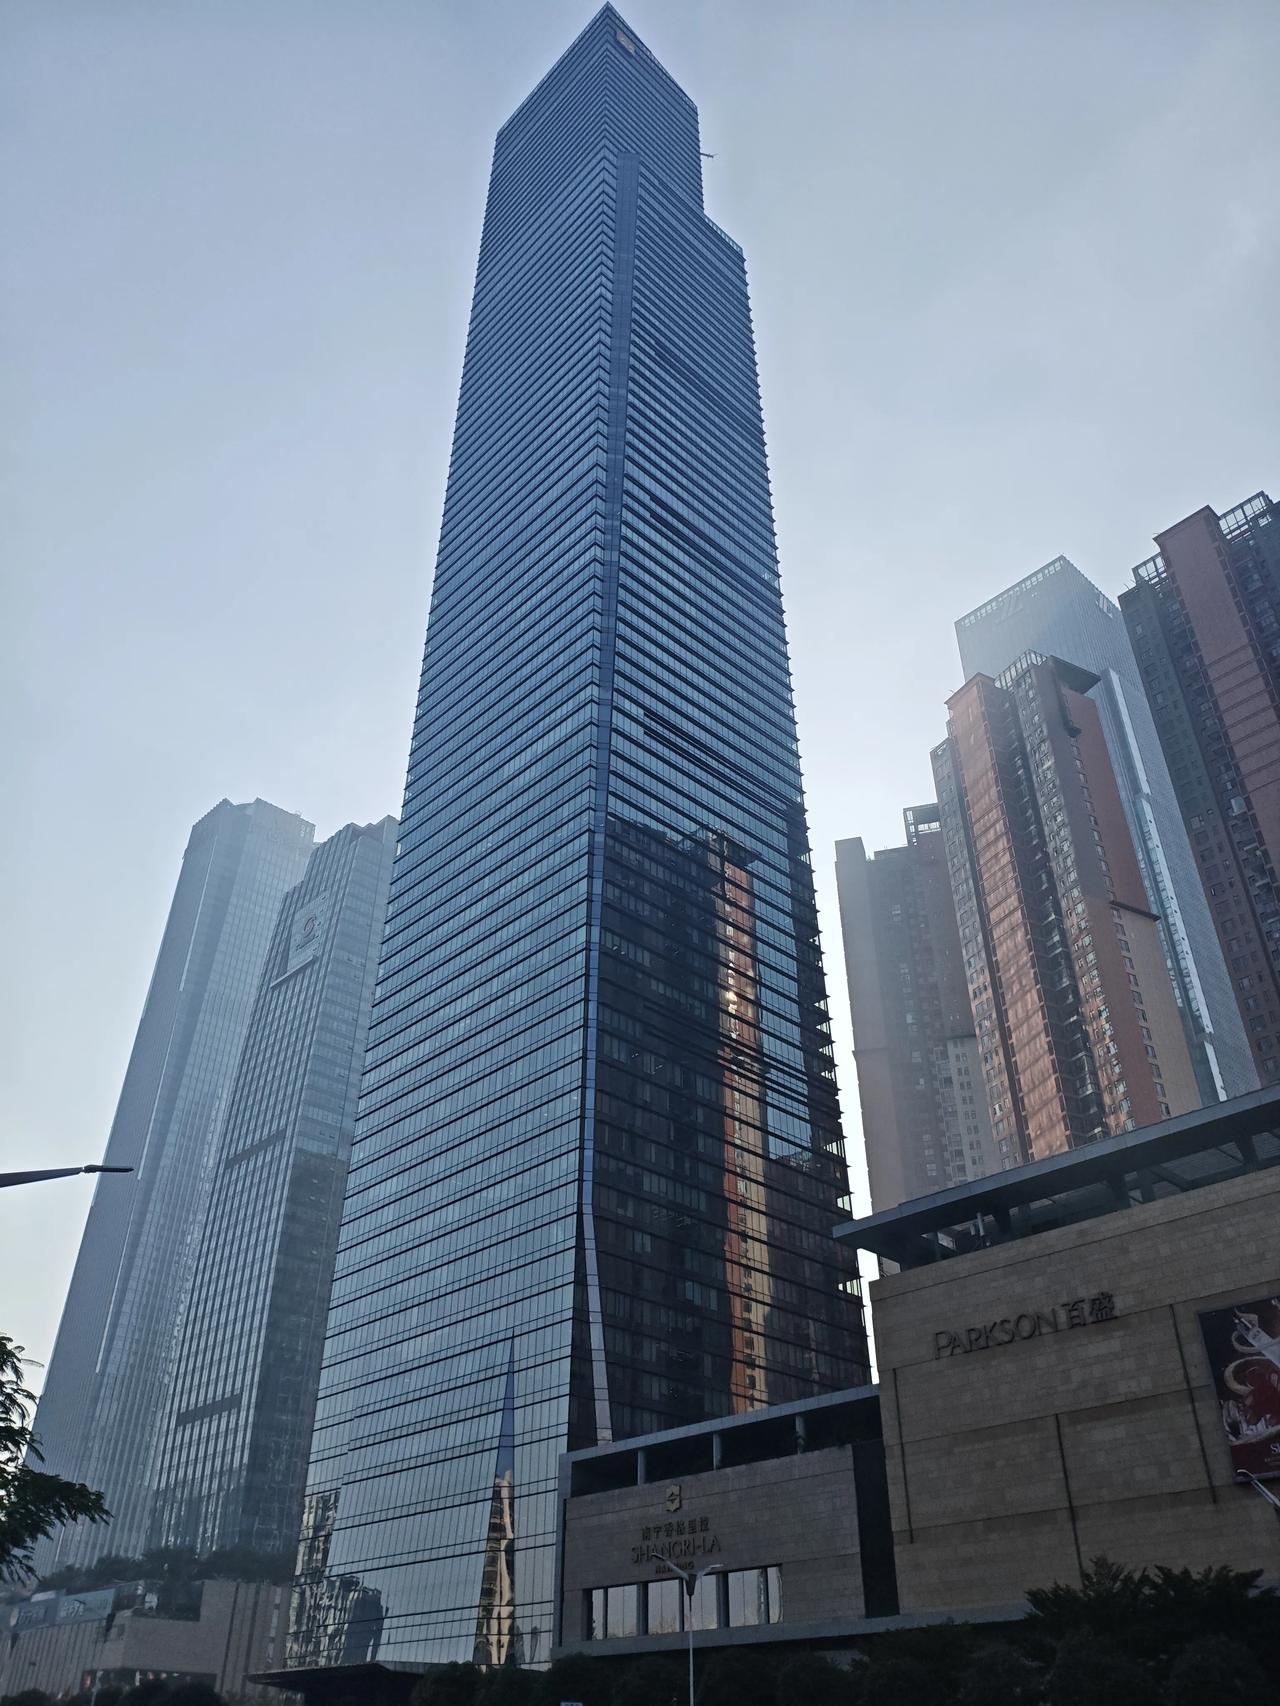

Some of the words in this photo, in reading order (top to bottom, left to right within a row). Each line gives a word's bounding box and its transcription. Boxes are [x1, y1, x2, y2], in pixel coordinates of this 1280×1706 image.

[935, 1308, 1058, 1360] PARKSON
[1061, 1292, 1117, 1328] 百盛
[632, 1536, 721, 1563] SHANGRI-LA
